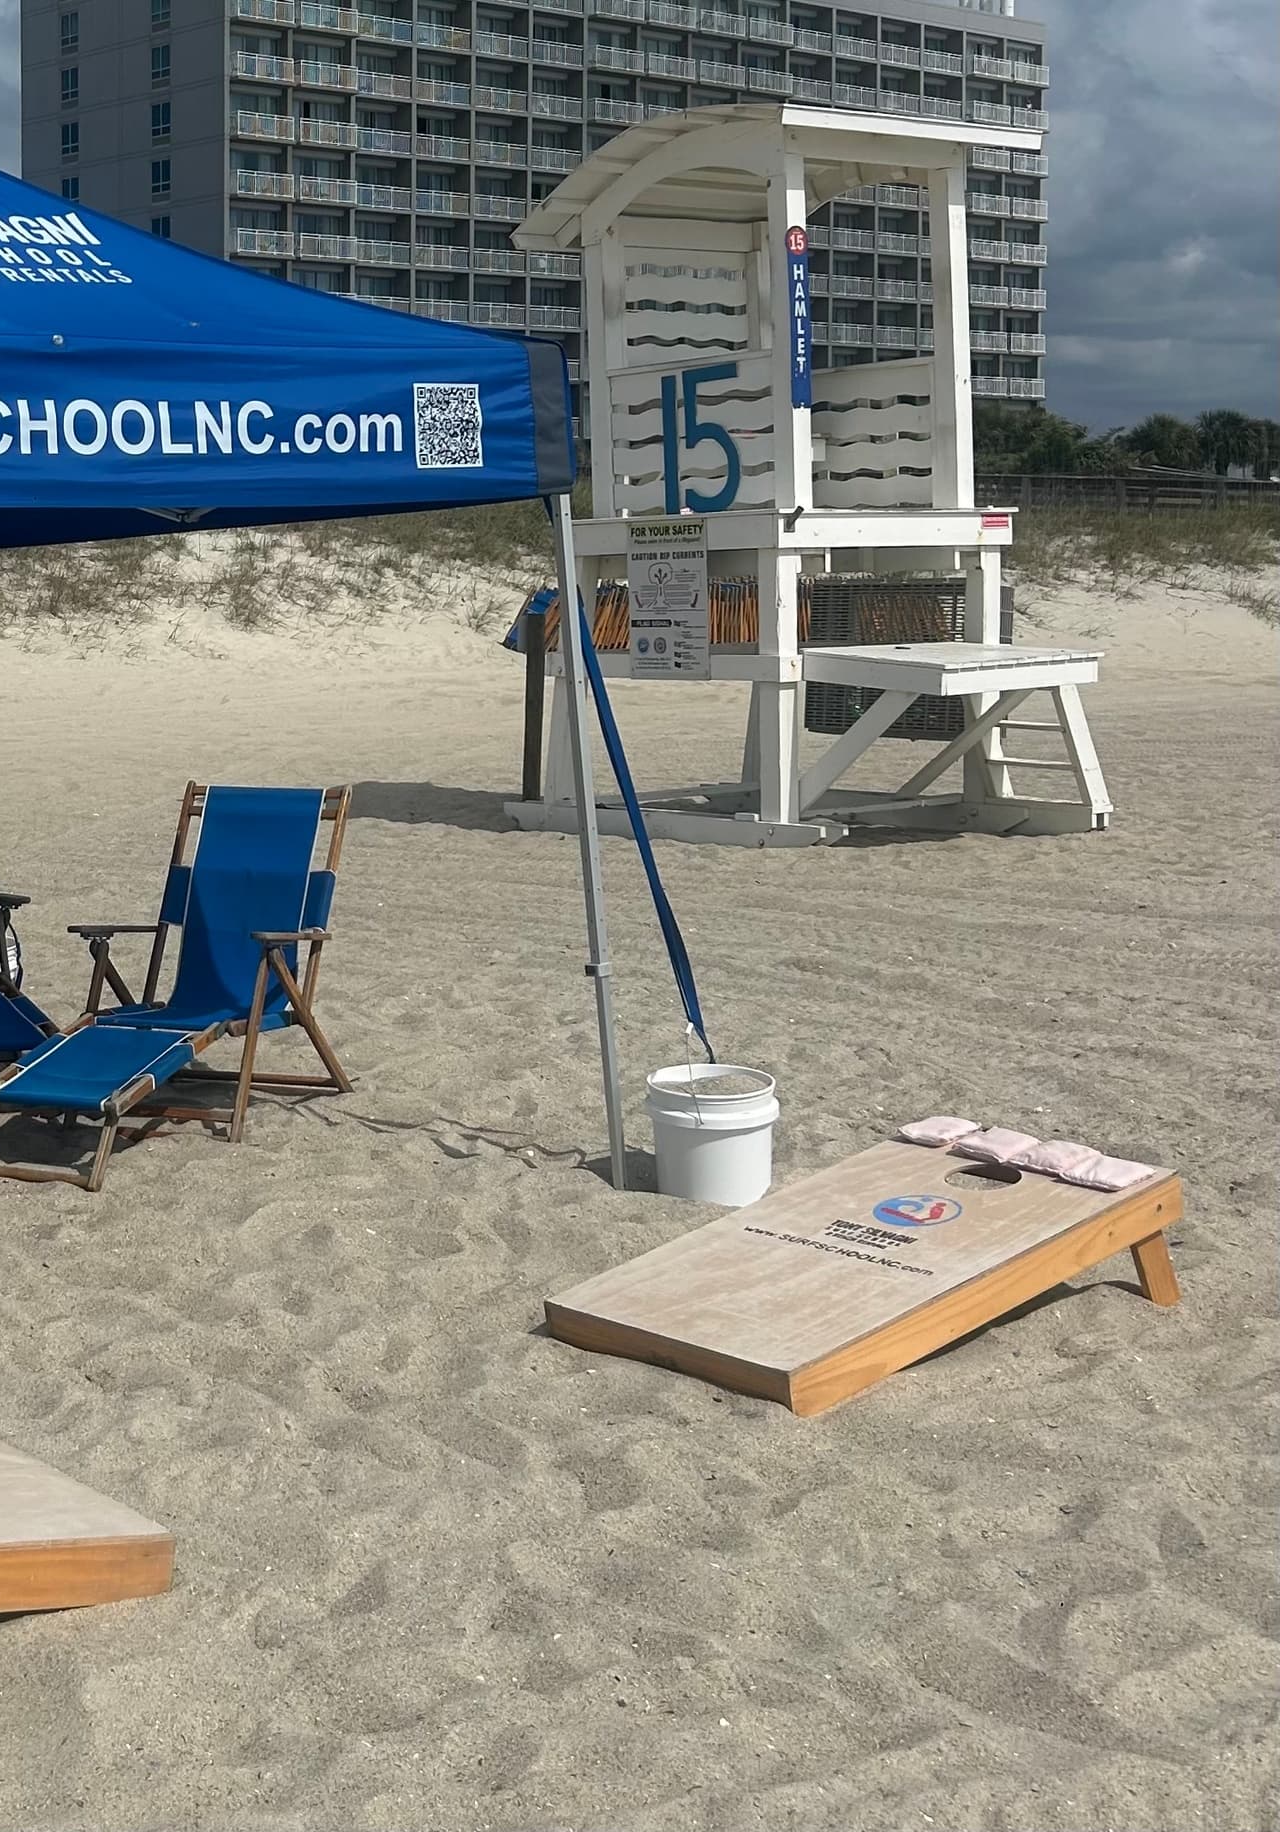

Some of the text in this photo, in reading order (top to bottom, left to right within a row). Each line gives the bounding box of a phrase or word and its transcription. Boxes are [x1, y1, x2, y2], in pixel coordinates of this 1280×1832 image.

[790, 234, 804, 250] 15
[1, 265, 133, 285] RENTALS
[792, 263, 808, 375] HAMLET
[661, 363, 741, 515] 15
[631, 524, 704, 538] FOR YOUR SAFETY
[631, 550, 704, 561] CAUTION RIP CURRENTS
[831, 1219, 919, 1244] TONY SILVAGNI
[743, 1225, 935, 1276] www.SURFSCHOOLNC.com
